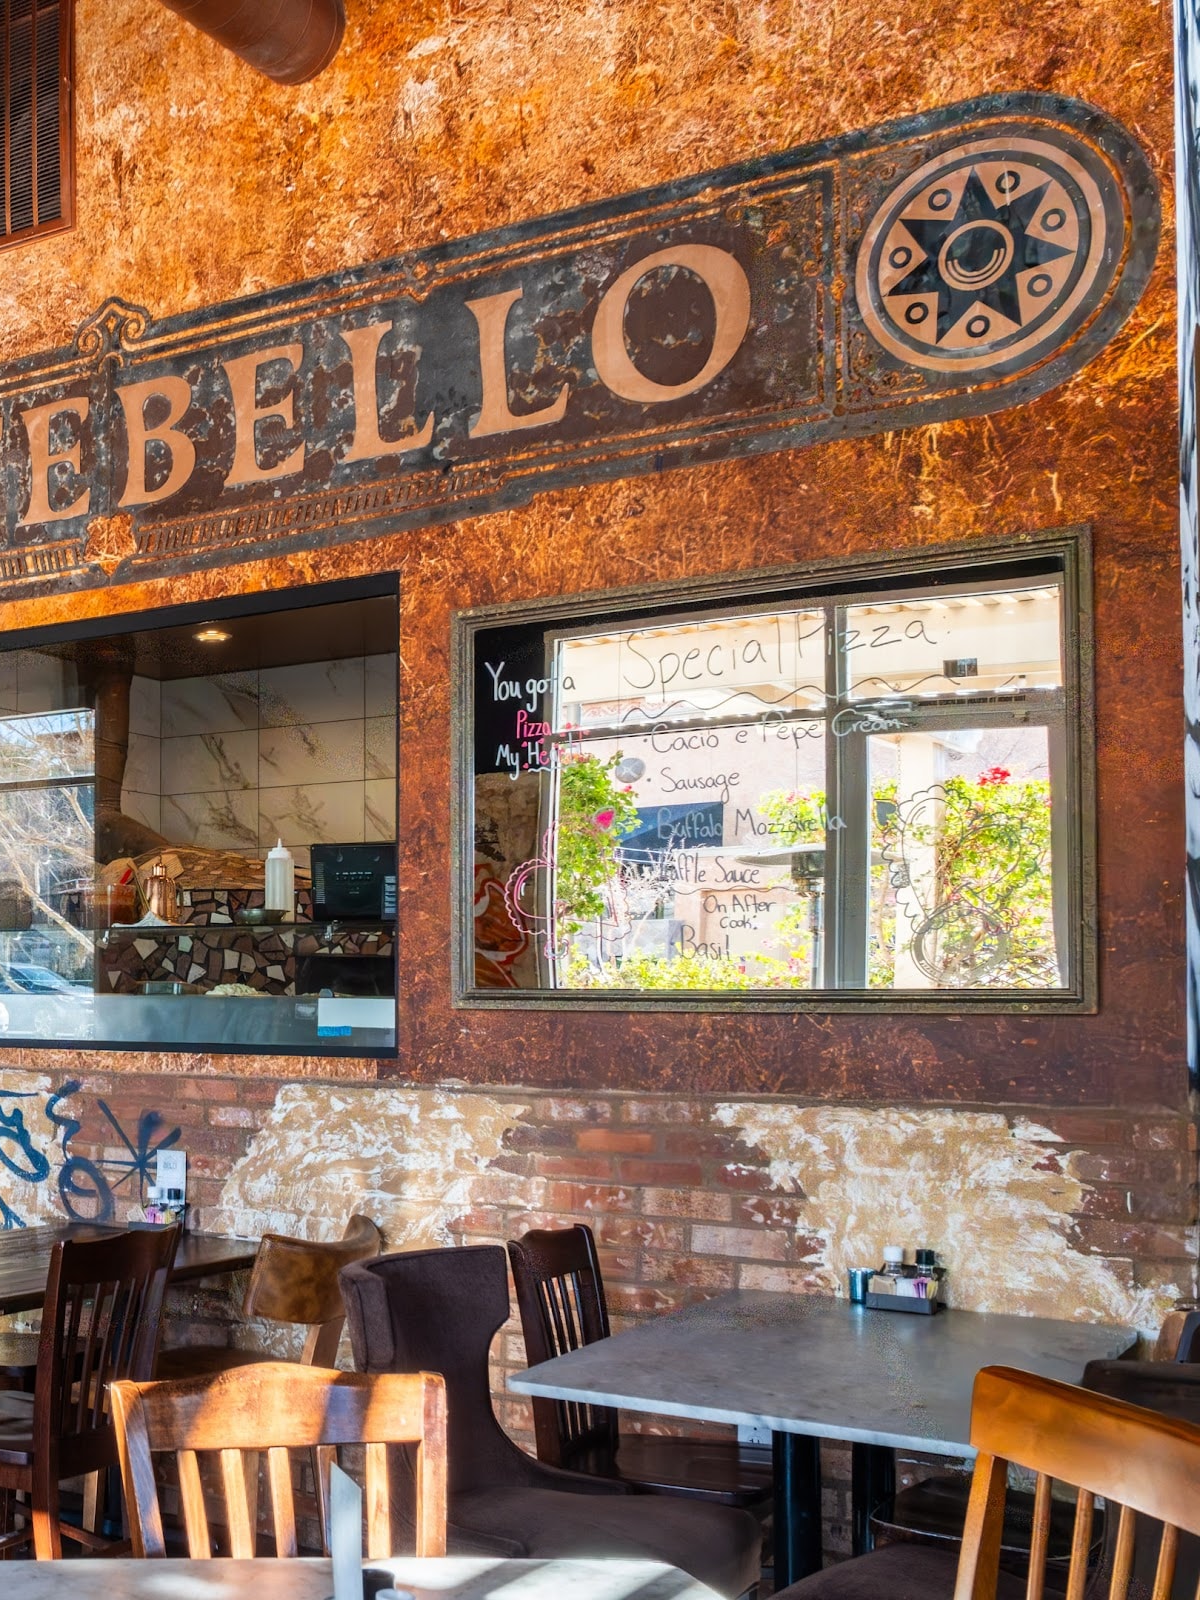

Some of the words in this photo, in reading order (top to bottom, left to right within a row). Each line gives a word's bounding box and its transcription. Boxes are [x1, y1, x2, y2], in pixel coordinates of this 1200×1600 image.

[623, 616, 783, 702] Special
[484, 661, 522, 701] You
[516, 709, 552, 739] Pizza
[651, 723, 719, 754] Cacio
[735, 729, 748, 744] e
[762, 710, 823, 750] Pepe
[832, 708, 906, 737] Cream
[495, 743, 520, 780] My
[660, 766, 740, 805] Sausage
[657, 807, 722, 840] Buffalo
[714, 855, 761, 884] Sauce
[703, 894, 727, 914] On
[732, 893, 777, 914] After
